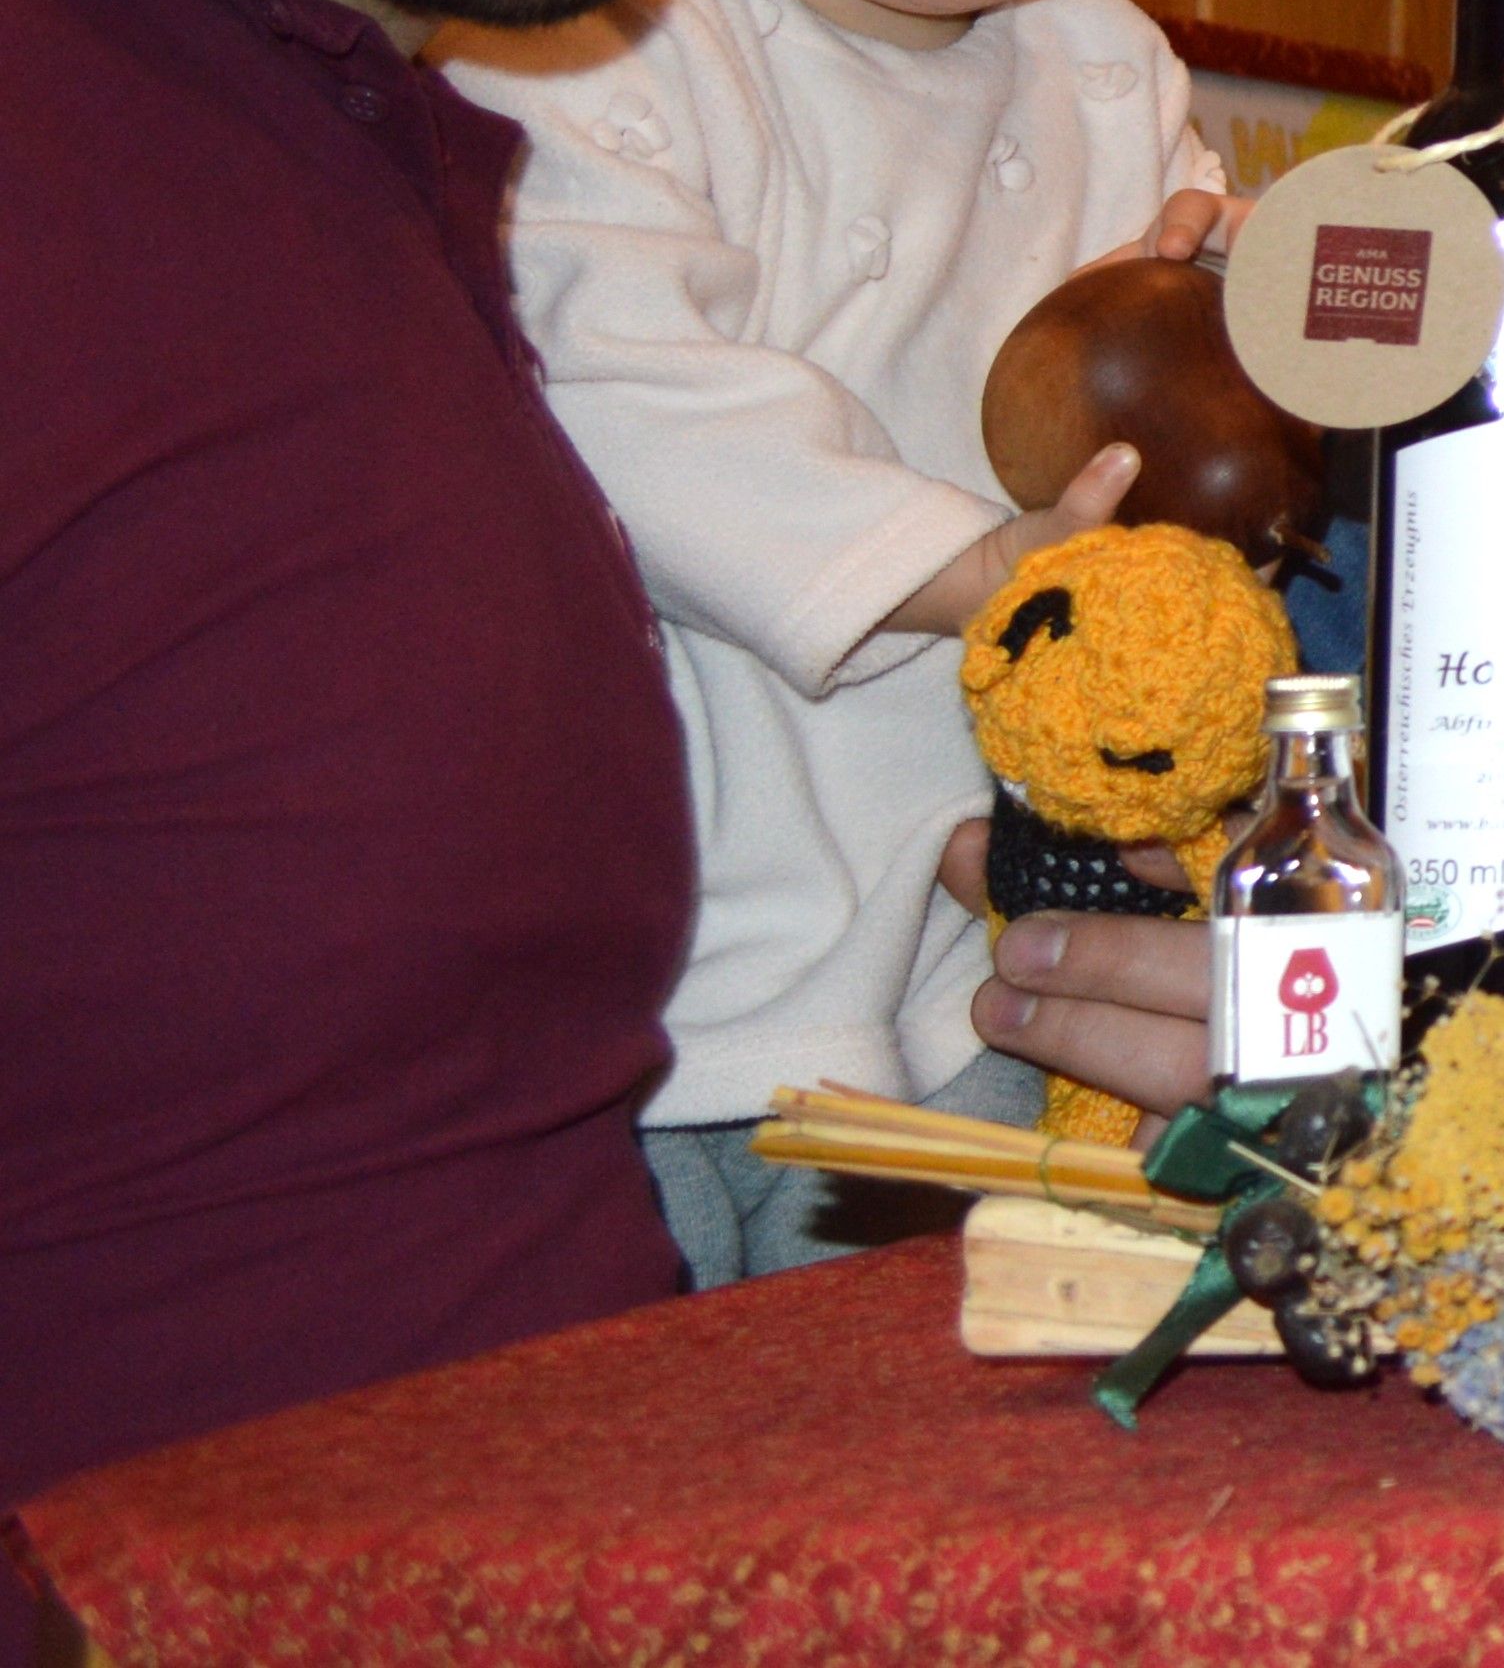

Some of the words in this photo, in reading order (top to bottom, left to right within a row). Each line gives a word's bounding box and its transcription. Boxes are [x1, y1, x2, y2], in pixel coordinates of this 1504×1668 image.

[1316, 263, 1422, 289] GENUSS
[1315, 287, 1418, 311] REGION
[1408, 859, 1458, 885] 350
[1282, 1012, 1329, 1058] LB
